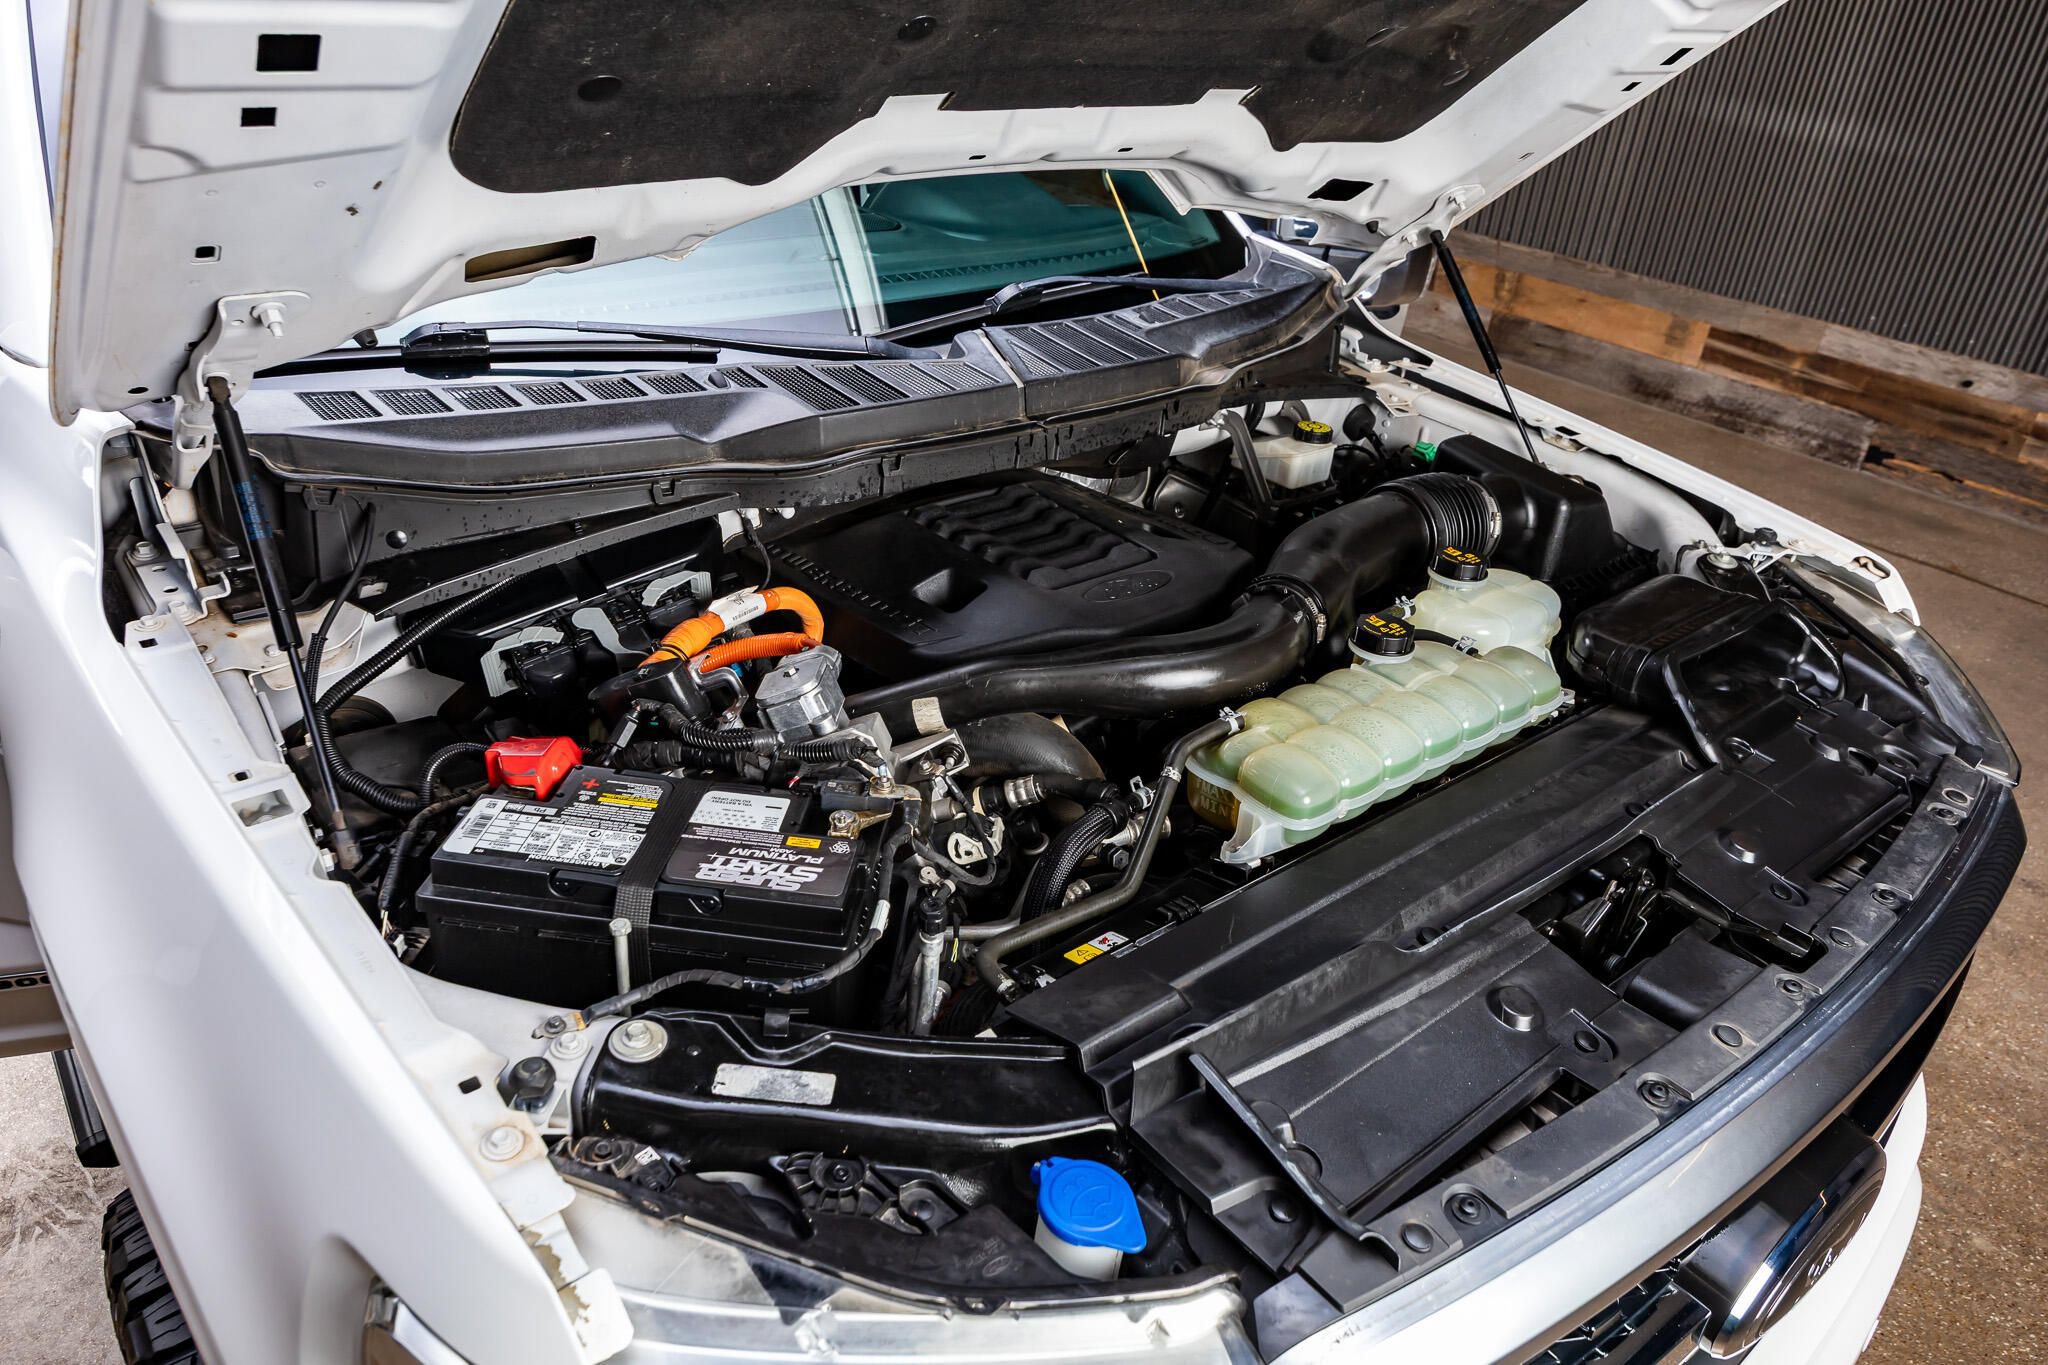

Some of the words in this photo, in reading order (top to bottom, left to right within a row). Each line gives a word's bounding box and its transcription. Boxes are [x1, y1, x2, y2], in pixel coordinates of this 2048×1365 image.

[1200, 795, 1229, 817] MIN
[728, 847, 825, 865] PLATINUM
[695, 866, 801, 892] SUPER
[699, 855, 824, 883] START
